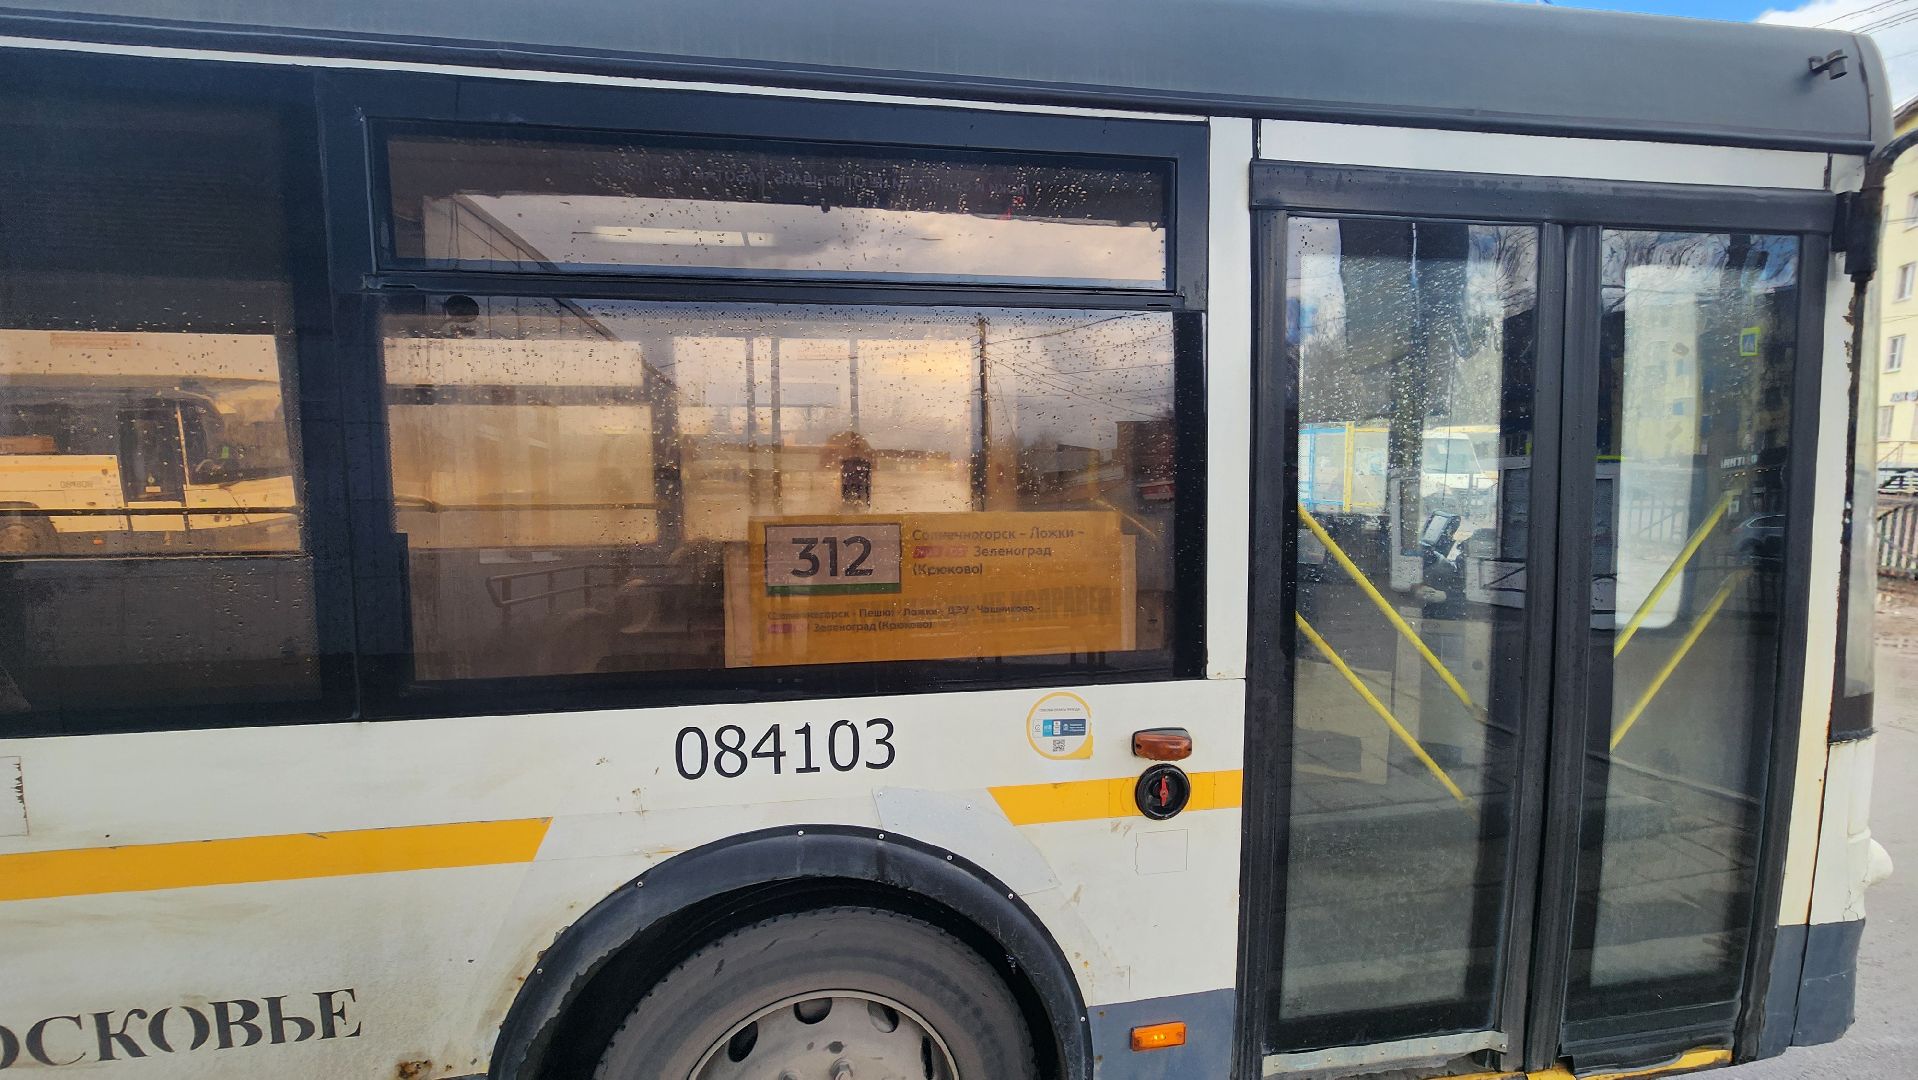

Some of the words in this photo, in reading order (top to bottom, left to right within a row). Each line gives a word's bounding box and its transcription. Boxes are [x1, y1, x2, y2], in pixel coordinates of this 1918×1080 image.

[1030, 526, 1074, 540] Ложки
[791, 536, 873, 577] 312
[973, 545, 1052, 558] Зеленоград
[912, 562, 983, 577] (Крюково)
[675, 717, 896, 780] 084103
